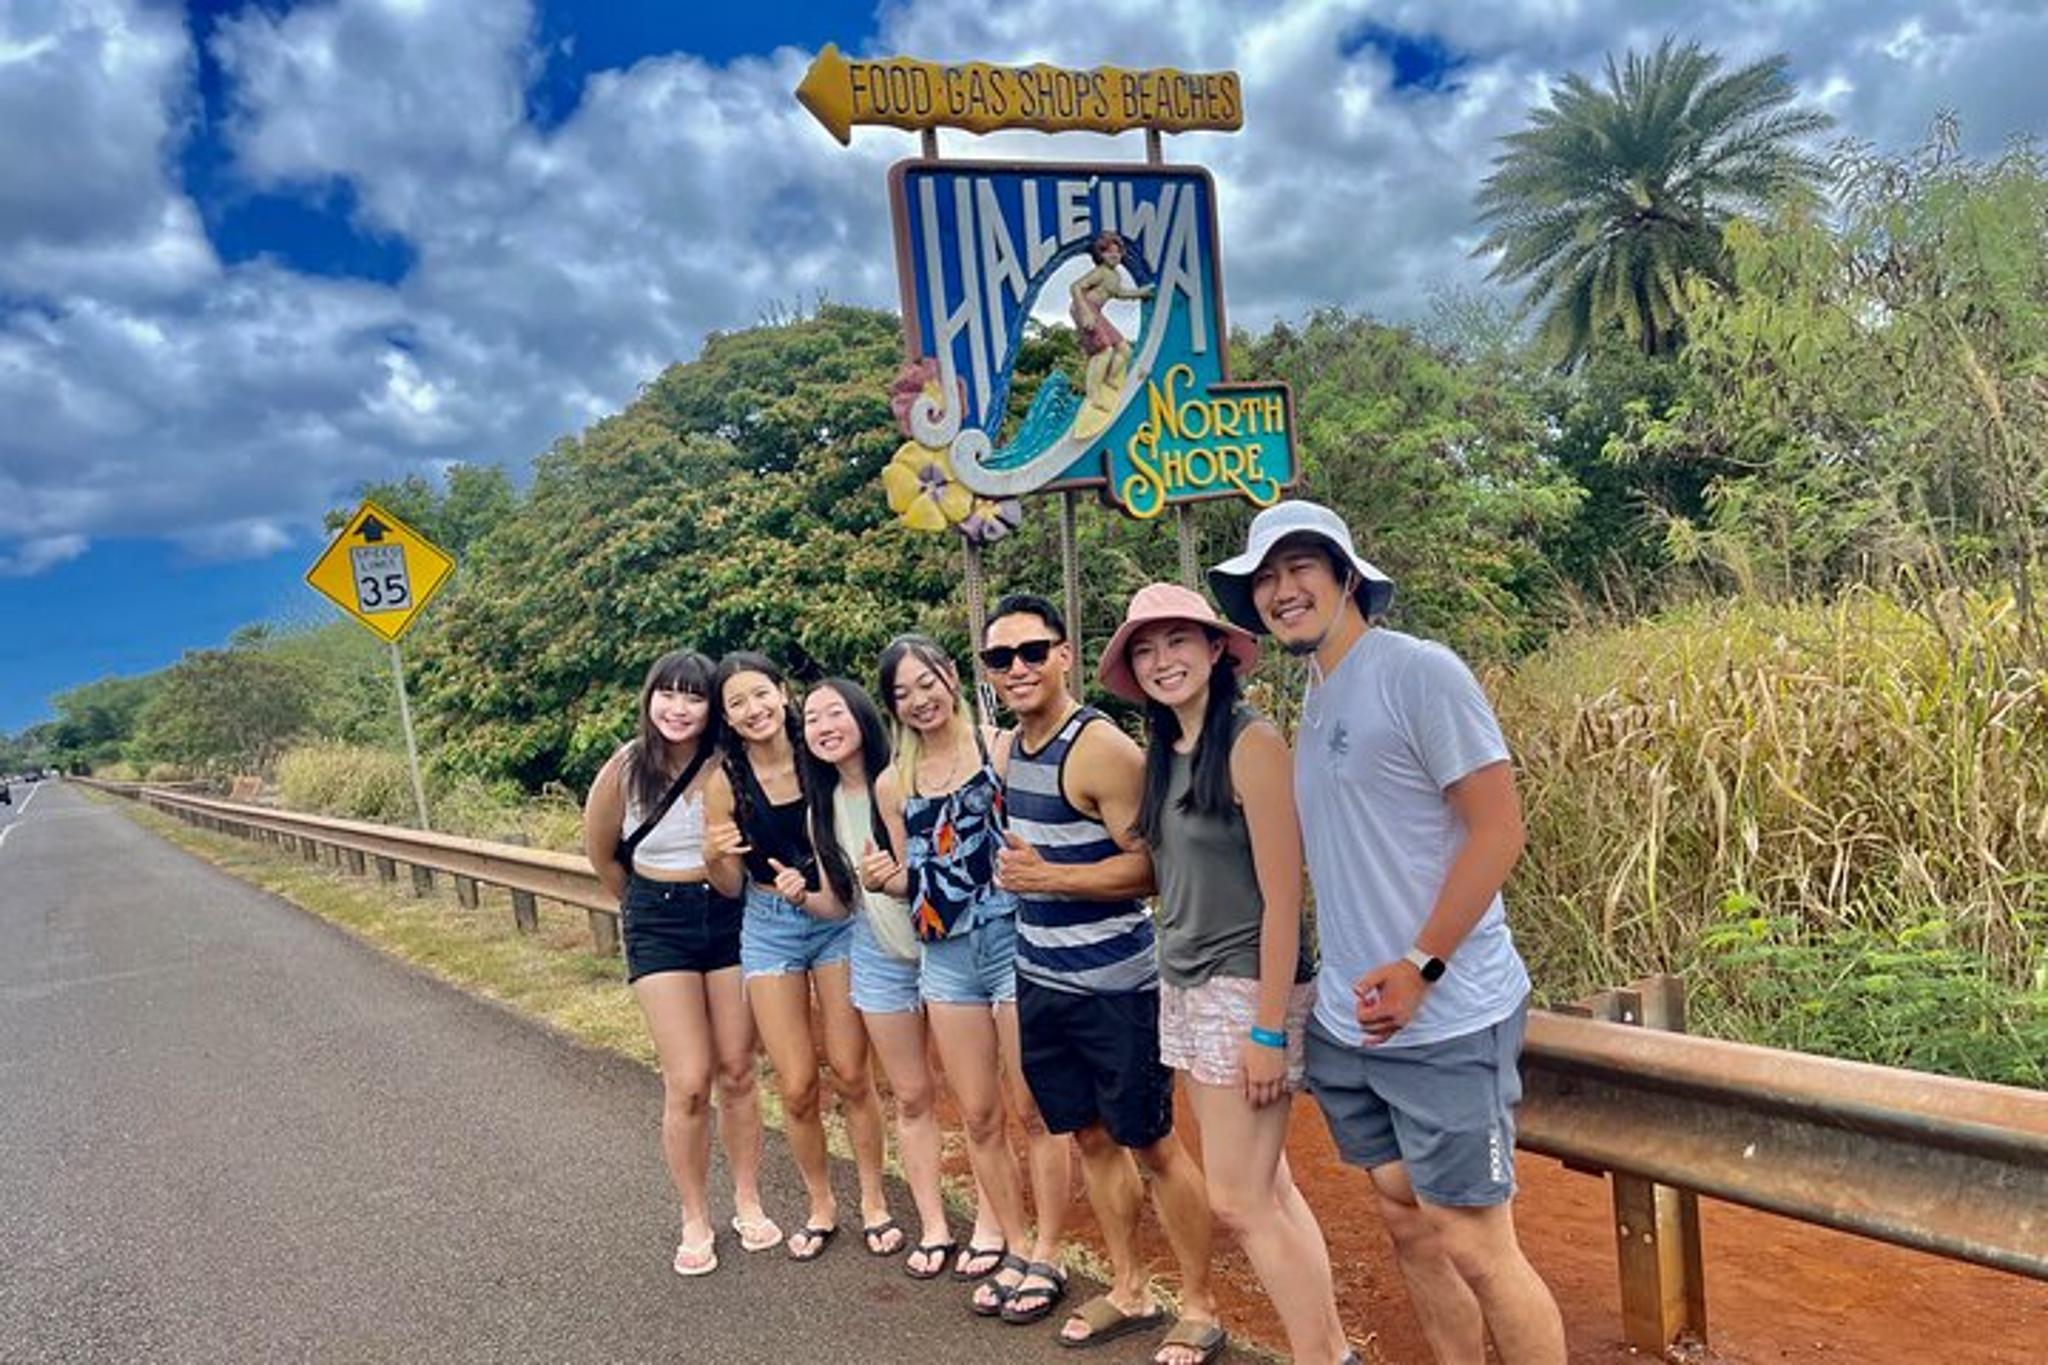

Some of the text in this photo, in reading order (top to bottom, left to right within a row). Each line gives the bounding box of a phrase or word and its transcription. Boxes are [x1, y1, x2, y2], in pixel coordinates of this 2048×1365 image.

[850, 64, 1236, 120] FOOD GAS SHOPS BEACHES
[1147, 364, 1284, 458] NORTH
[1122, 421, 1280, 519] SHORE
[360, 574, 408, 607] 35
